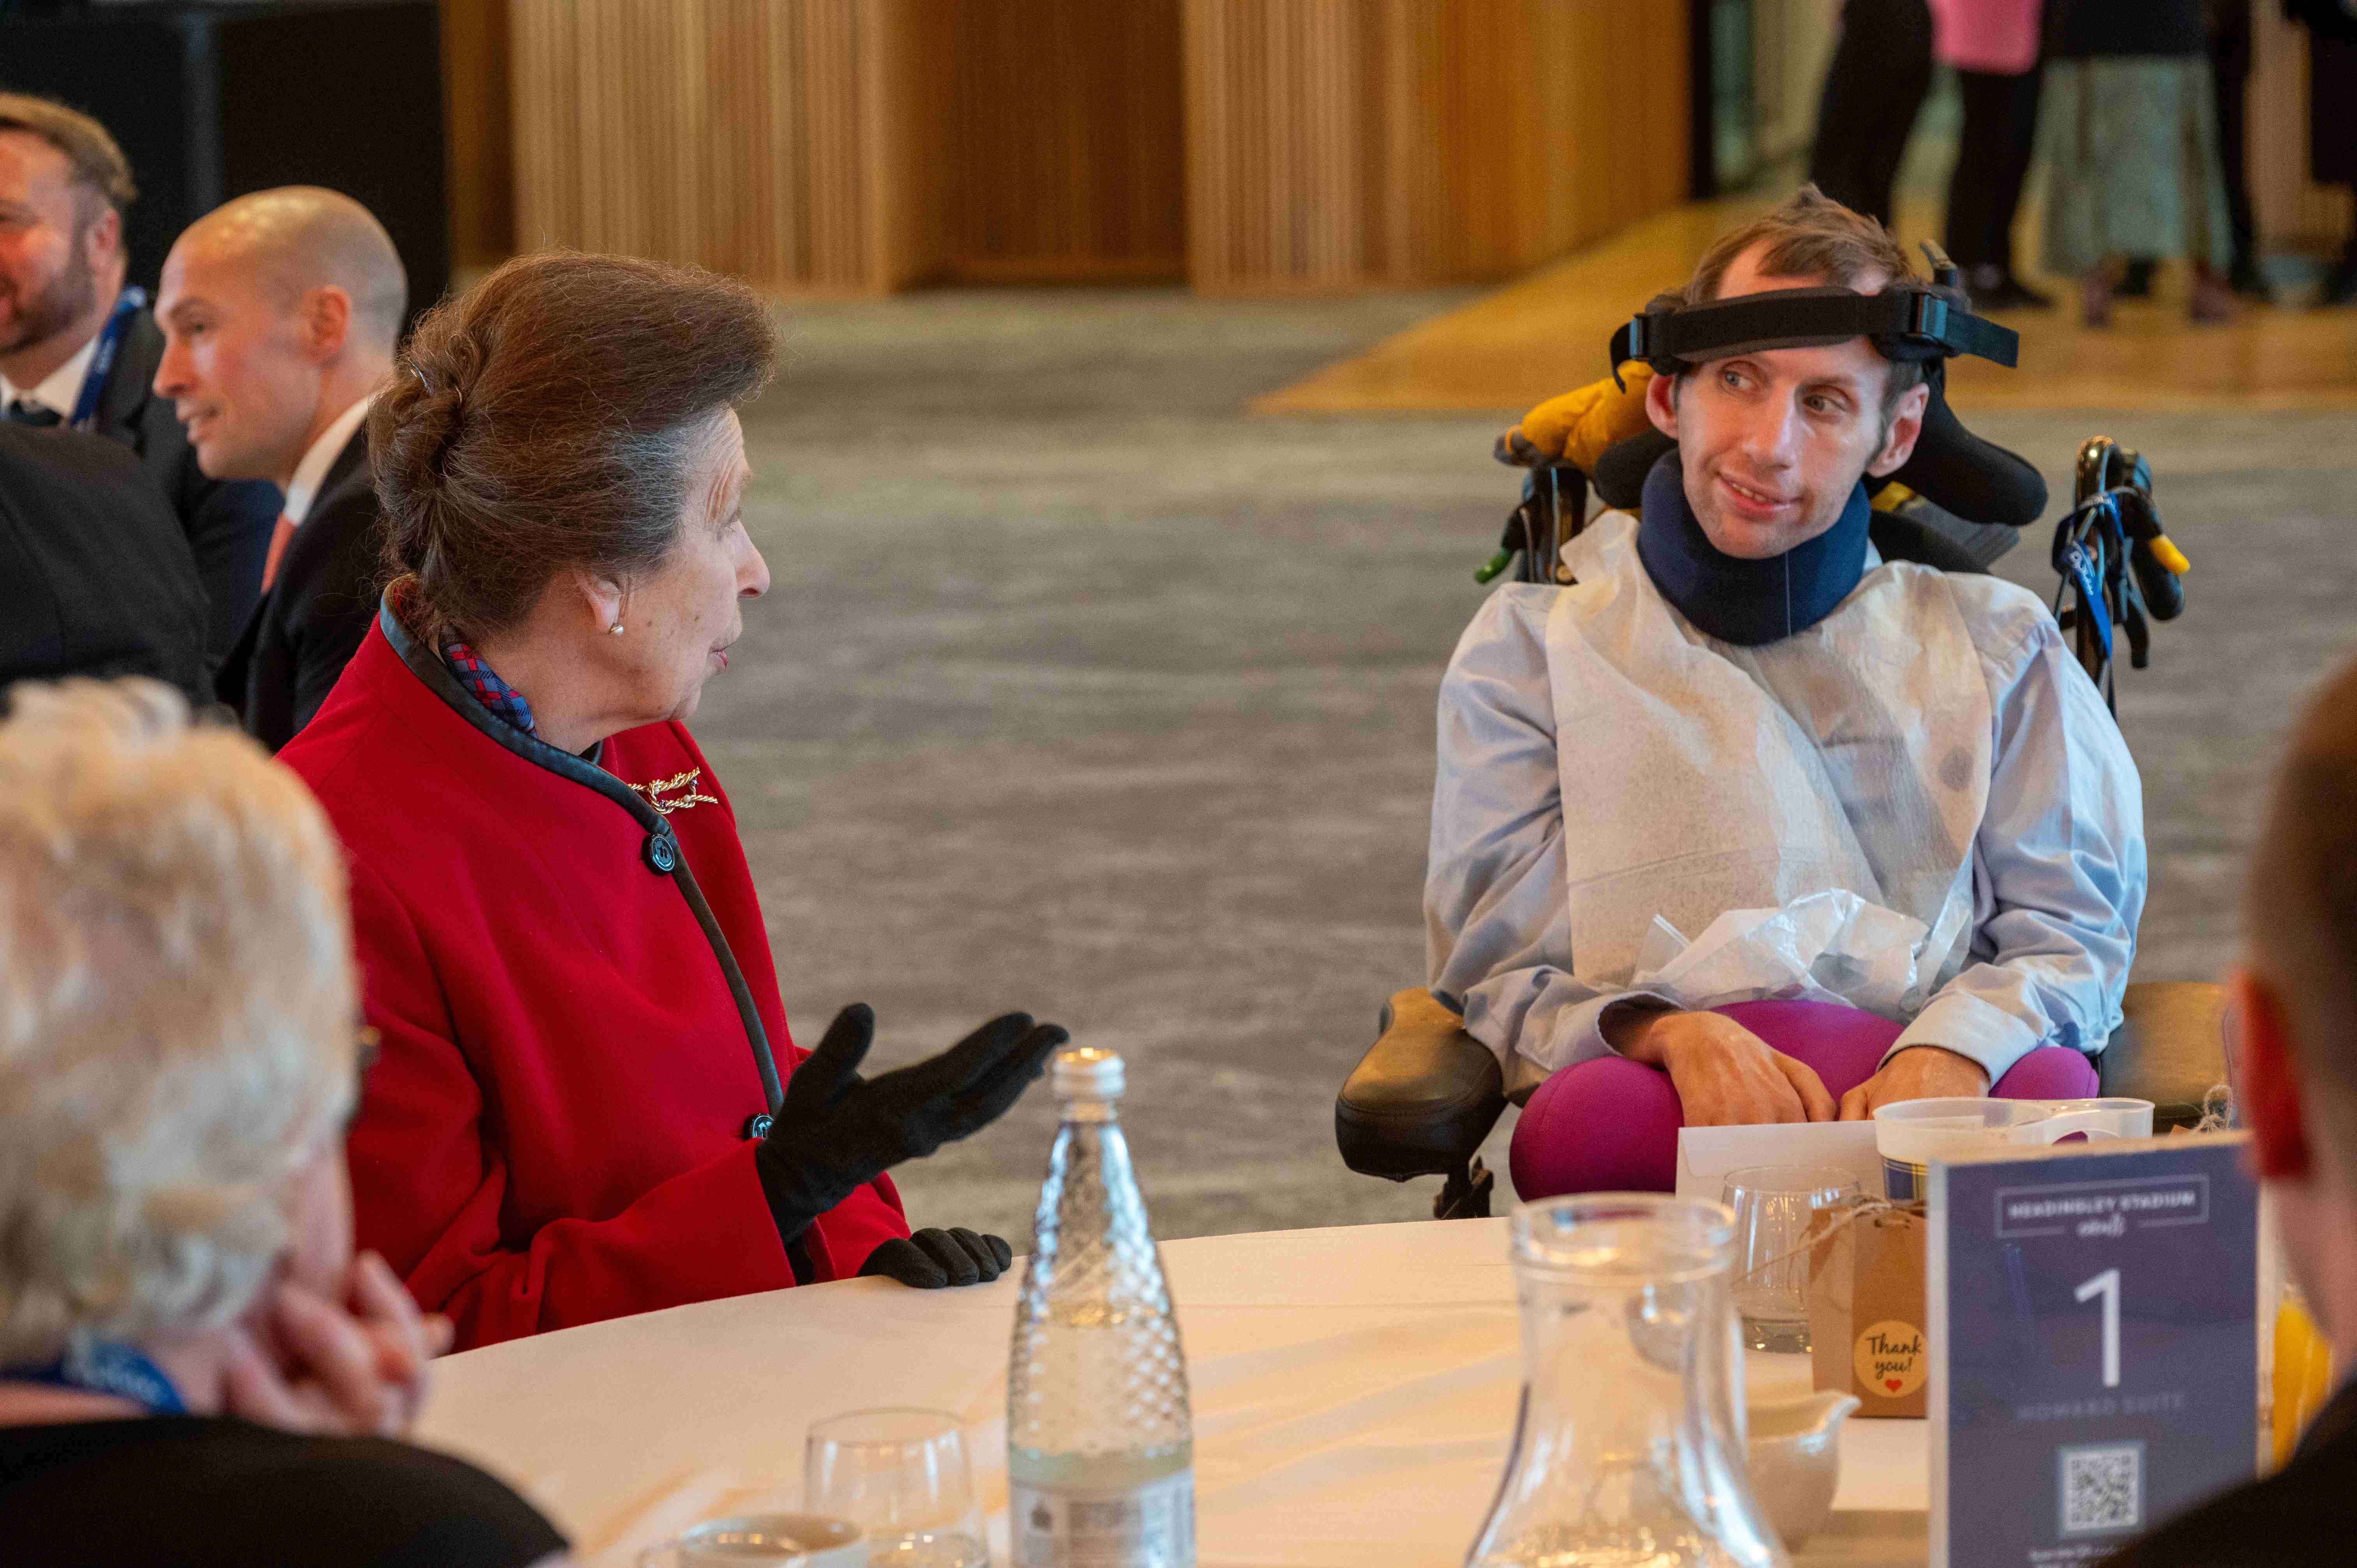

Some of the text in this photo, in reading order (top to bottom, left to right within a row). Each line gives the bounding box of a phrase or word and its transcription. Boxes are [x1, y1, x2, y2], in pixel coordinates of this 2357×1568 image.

[2075, 1269, 2120, 1387] 1
[1865, 1332, 1922, 1356] Thank
[1875, 1357, 1912, 1380] you!
